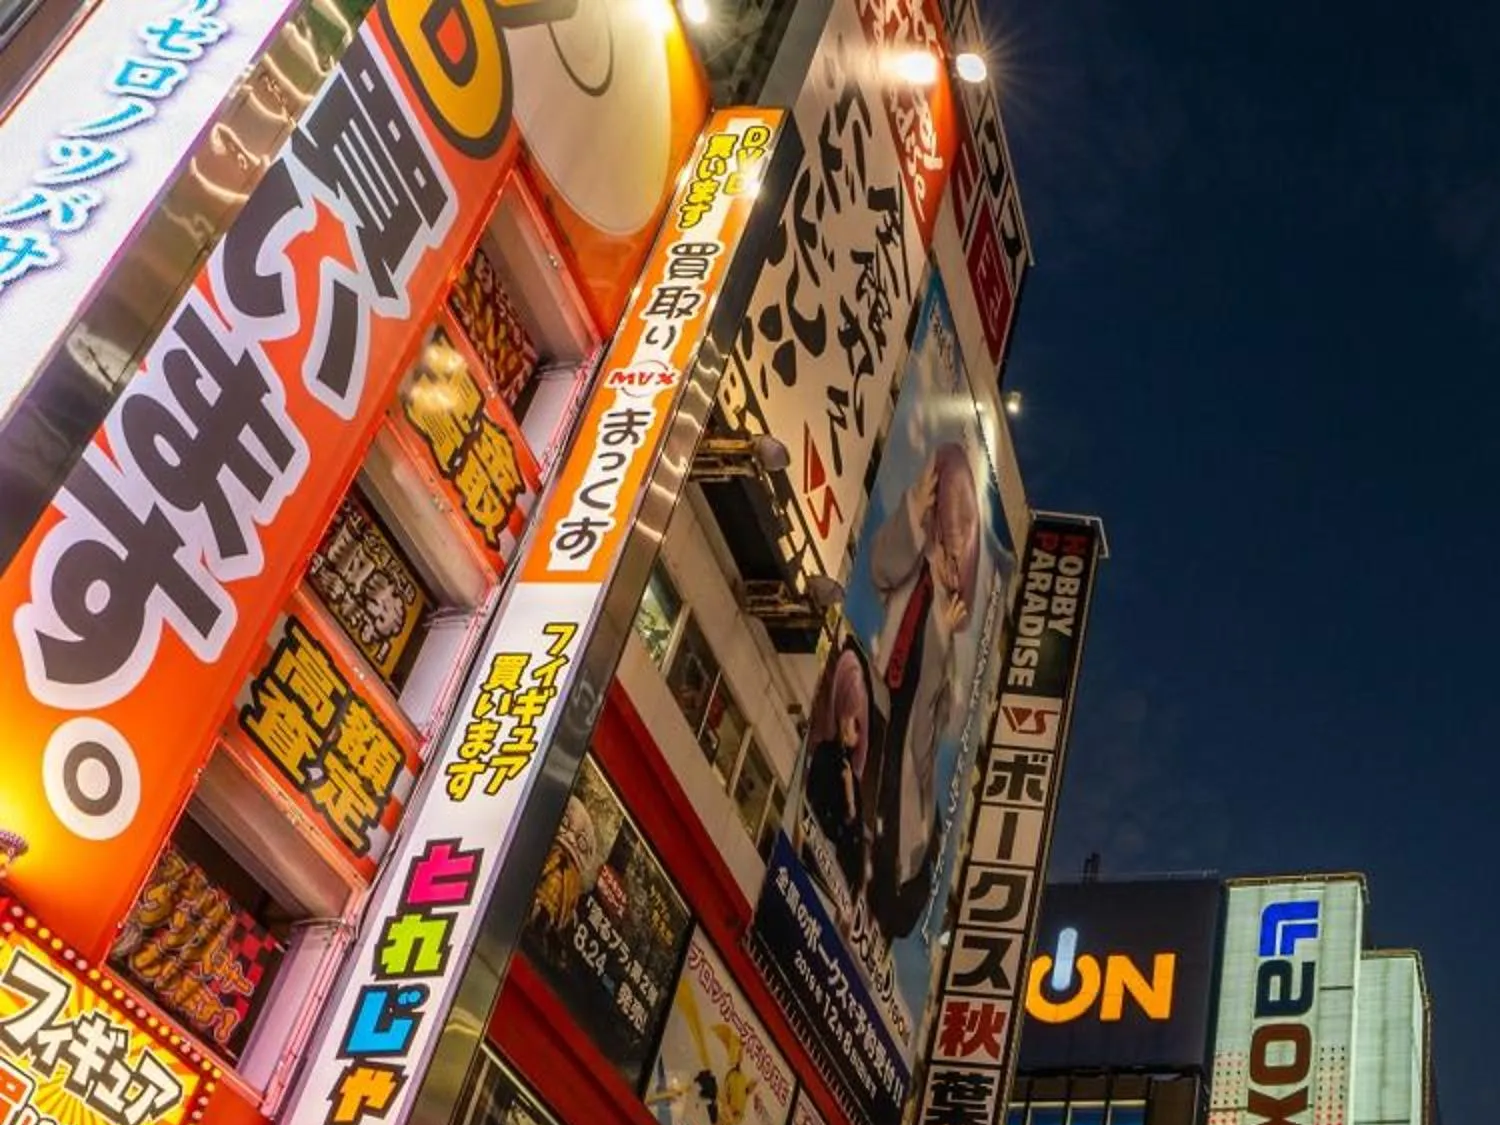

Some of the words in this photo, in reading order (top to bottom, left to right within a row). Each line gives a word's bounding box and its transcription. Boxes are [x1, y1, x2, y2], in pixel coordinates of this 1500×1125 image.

[644, 242, 721, 350] 買取り
[555, 407, 655, 565] まっくす
[1007, 529, 1059, 689] PARADISE
[1054, 534, 1087, 638] HOBBY
[444, 652, 531, 801] 買います
[482, 622, 579, 796] フィギュア
